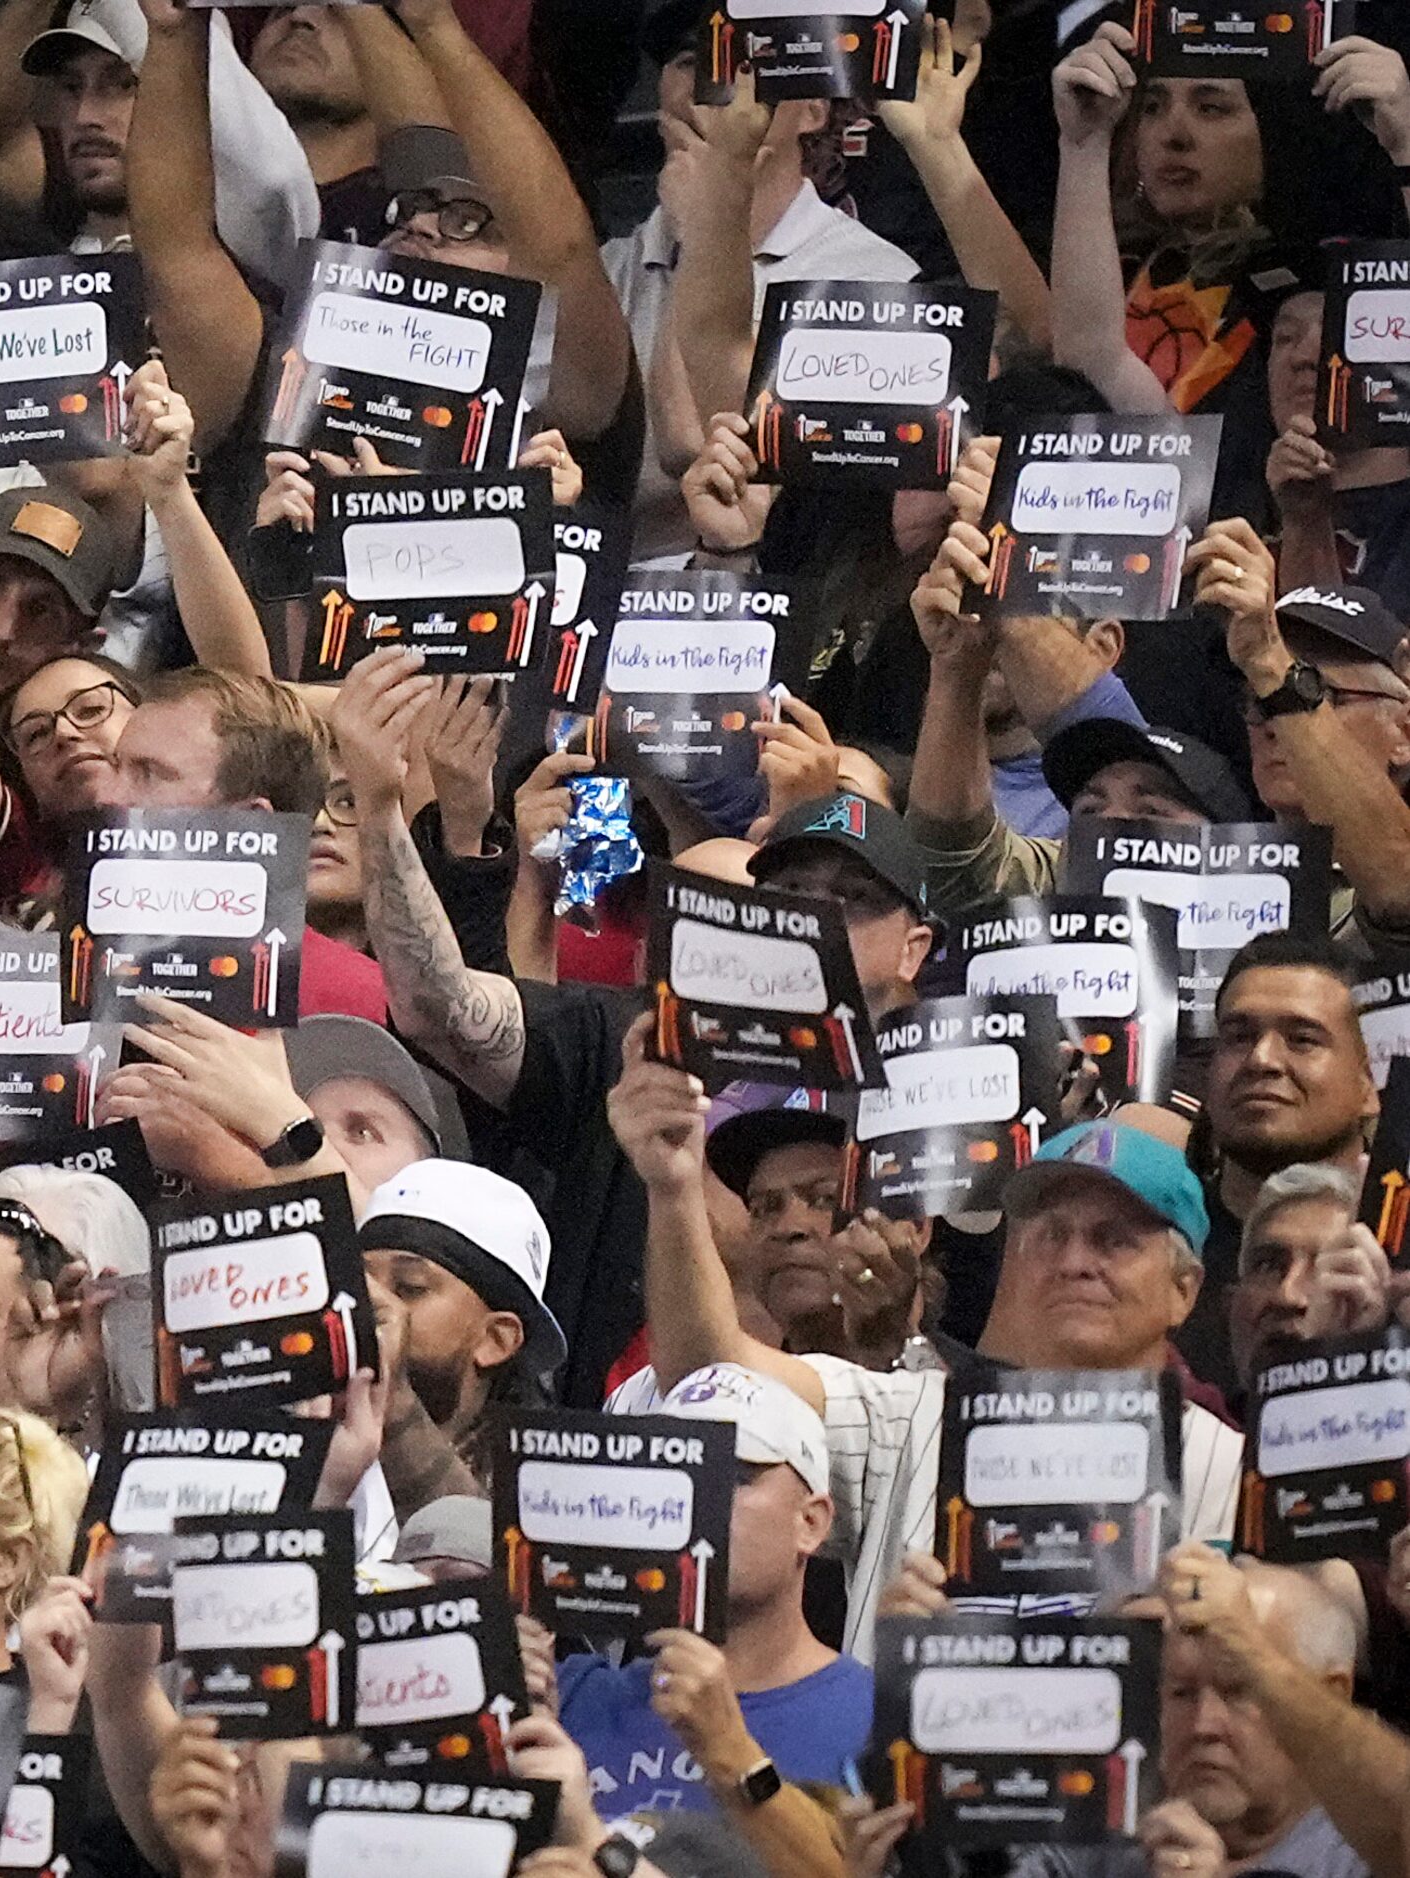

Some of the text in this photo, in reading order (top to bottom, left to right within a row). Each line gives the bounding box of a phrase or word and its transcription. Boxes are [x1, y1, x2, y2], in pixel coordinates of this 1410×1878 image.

[19, 277, 53, 300] UP
[60, 272, 112, 296] FOR
[313, 261, 505, 317] I STAND UP FOR
[320, 306, 432, 341] Those in the
[780, 296, 963, 326] I STAND UP FOR
[53, 327, 93, 357] Lost
[409, 342, 483, 370] FIGHT
[783, 346, 945, 392] LOVED ONES
[5, 406, 49, 421] TOGETHER
[366, 401, 412, 421] TOGETHER
[326, 417, 422, 448] StandUpToCancer.org
[1018, 432, 1191, 457] I STAND UP FOR
[332, 485, 525, 517] I STAND UP FOR
[1018, 485, 1175, 517] Kids in the Fight
[366, 542, 465, 581] POPS
[619, 590, 789, 616] STAND UP FOR
[413, 621, 457, 634] TOGETHER
[612, 644, 767, 675] Kids in the Fight
[87, 828, 277, 855] I STAND UP FOR
[1097, 838, 1299, 868] I STAND UP FOR
[92, 885, 257, 914] SURVIVORS
[1190, 902, 1284, 931] the Fight
[28, 952, 58, 973] UP
[152, 963, 198, 977] TOGETHER
[230, 1273, 310, 1309] ONES
[123, 1427, 303, 1457] I STAND UP FOR
[510, 1429, 703, 1464] I STAND UP FOR
[921, 1635, 1016, 1664] STAND
[1023, 1636, 1064, 1662] UP
[1072, 1636, 1129, 1663] FOR
